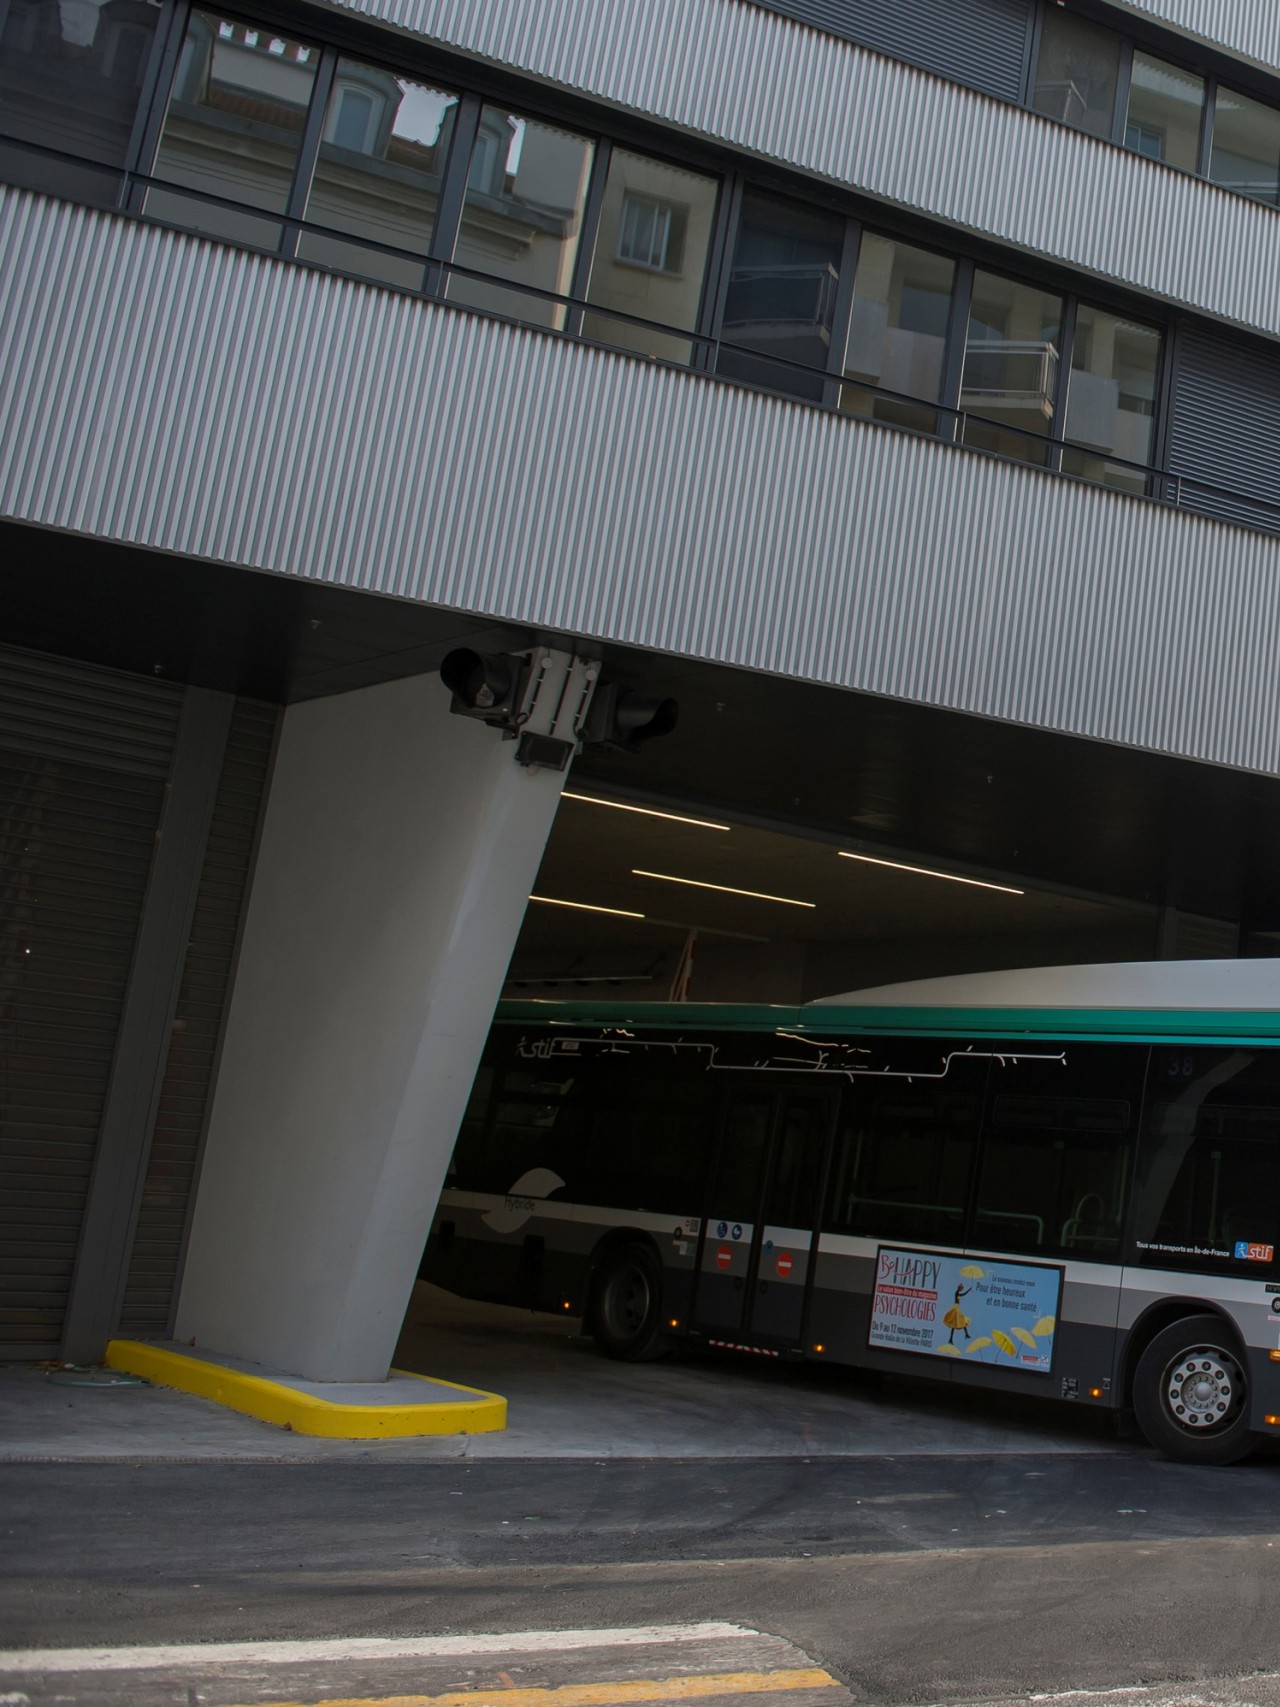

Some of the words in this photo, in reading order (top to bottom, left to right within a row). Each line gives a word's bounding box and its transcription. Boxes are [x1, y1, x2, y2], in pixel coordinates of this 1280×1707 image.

[1136, 1241, 1149, 1249] Tous
[1159, 1243, 1186, 1253] transports
[1194, 1245, 1230, 1257] Île-de-France
[1249, 1245, 1274, 1259] stif
[893, 1257, 942, 1289] HAPPY
[976, 1282, 989, 1293] Pour
[990, 1284, 1002, 1295] être
[1002, 1285, 1026, 1298] heureux
[874, 1294, 937, 1321] PSYCHOLOGIES
[986, 1297, 993, 1306] et
[993, 1298, 1001, 1307] en
[1001, 1298, 1019, 1310] bonne
[1020, 1301, 1037, 1312] santé
